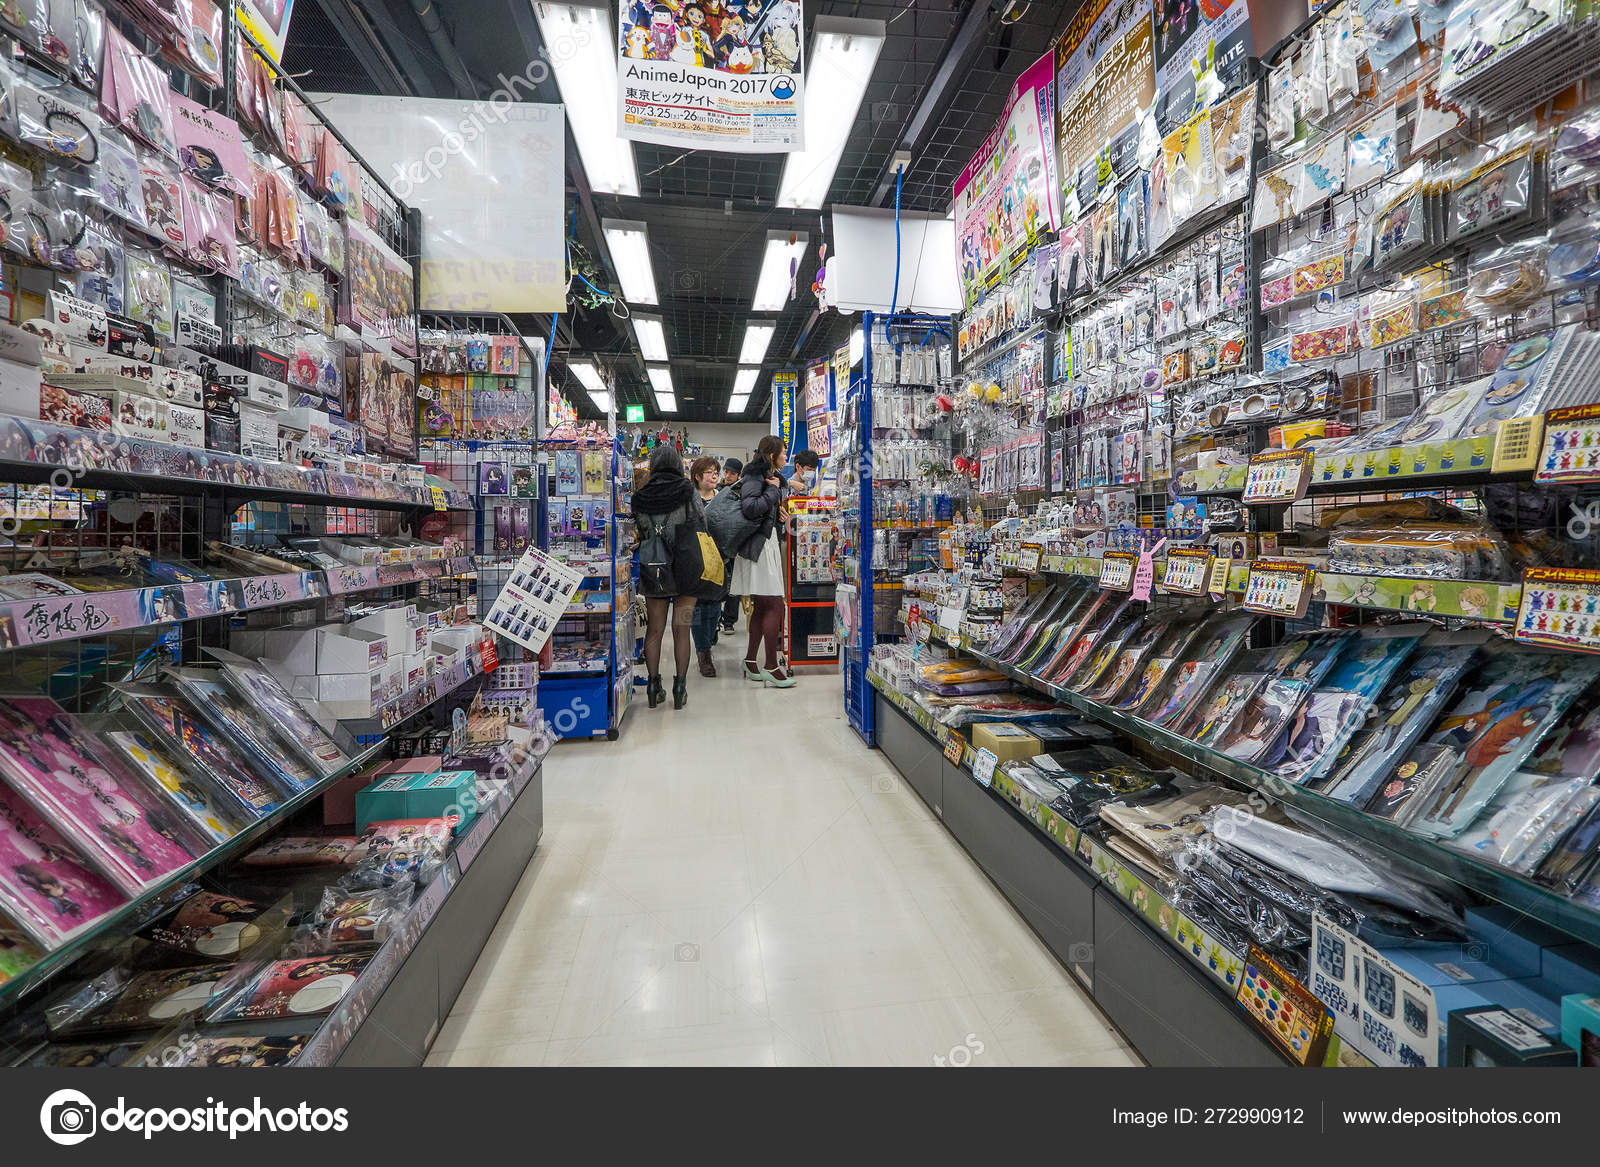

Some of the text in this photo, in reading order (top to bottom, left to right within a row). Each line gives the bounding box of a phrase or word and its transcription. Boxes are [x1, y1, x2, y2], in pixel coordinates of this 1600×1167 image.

[1215, 40, 1245, 72] HITE
[626, 63, 768, 93] AnimeJapan 2017
[625, 87, 715, 107] 東京ビッグサイト
[1061, 100, 1100, 149] BACKSTAGE
[1101, 72, 1128, 107] PARTY
[1130, 51, 1151, 79] 2016
[1111, 136, 1139, 163] BLACK
